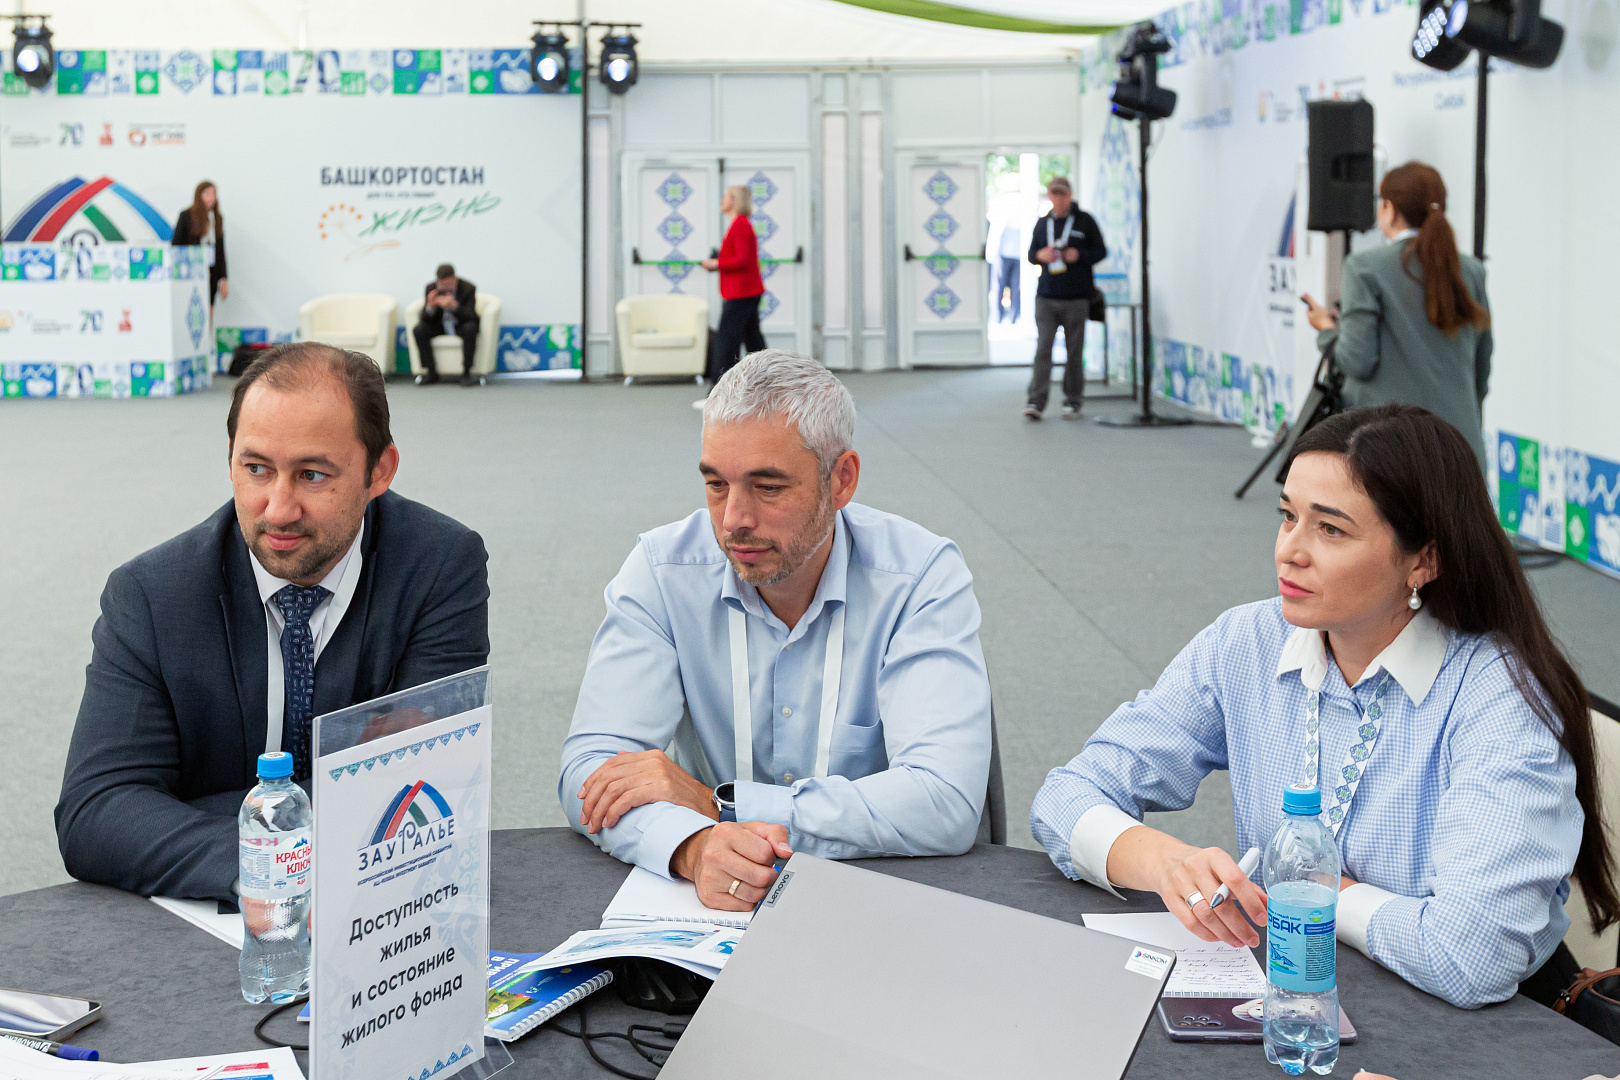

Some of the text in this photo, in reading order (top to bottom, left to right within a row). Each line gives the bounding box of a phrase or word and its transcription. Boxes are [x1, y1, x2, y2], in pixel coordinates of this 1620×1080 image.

[320, 166, 485, 186] БАШКОРТОСТАН
[358, 818, 455, 871] ЗАУРАЛЬЕ
[349, 883, 459, 946] Доступность
[767, 874, 790, 904] Lenovo
[379, 925, 432, 963] жилья
[351, 990, 362, 1010] и
[367, 946, 456, 1001] состояние
[340, 1003, 406, 1050] жилого
[410, 973, 463, 1017] фонда
